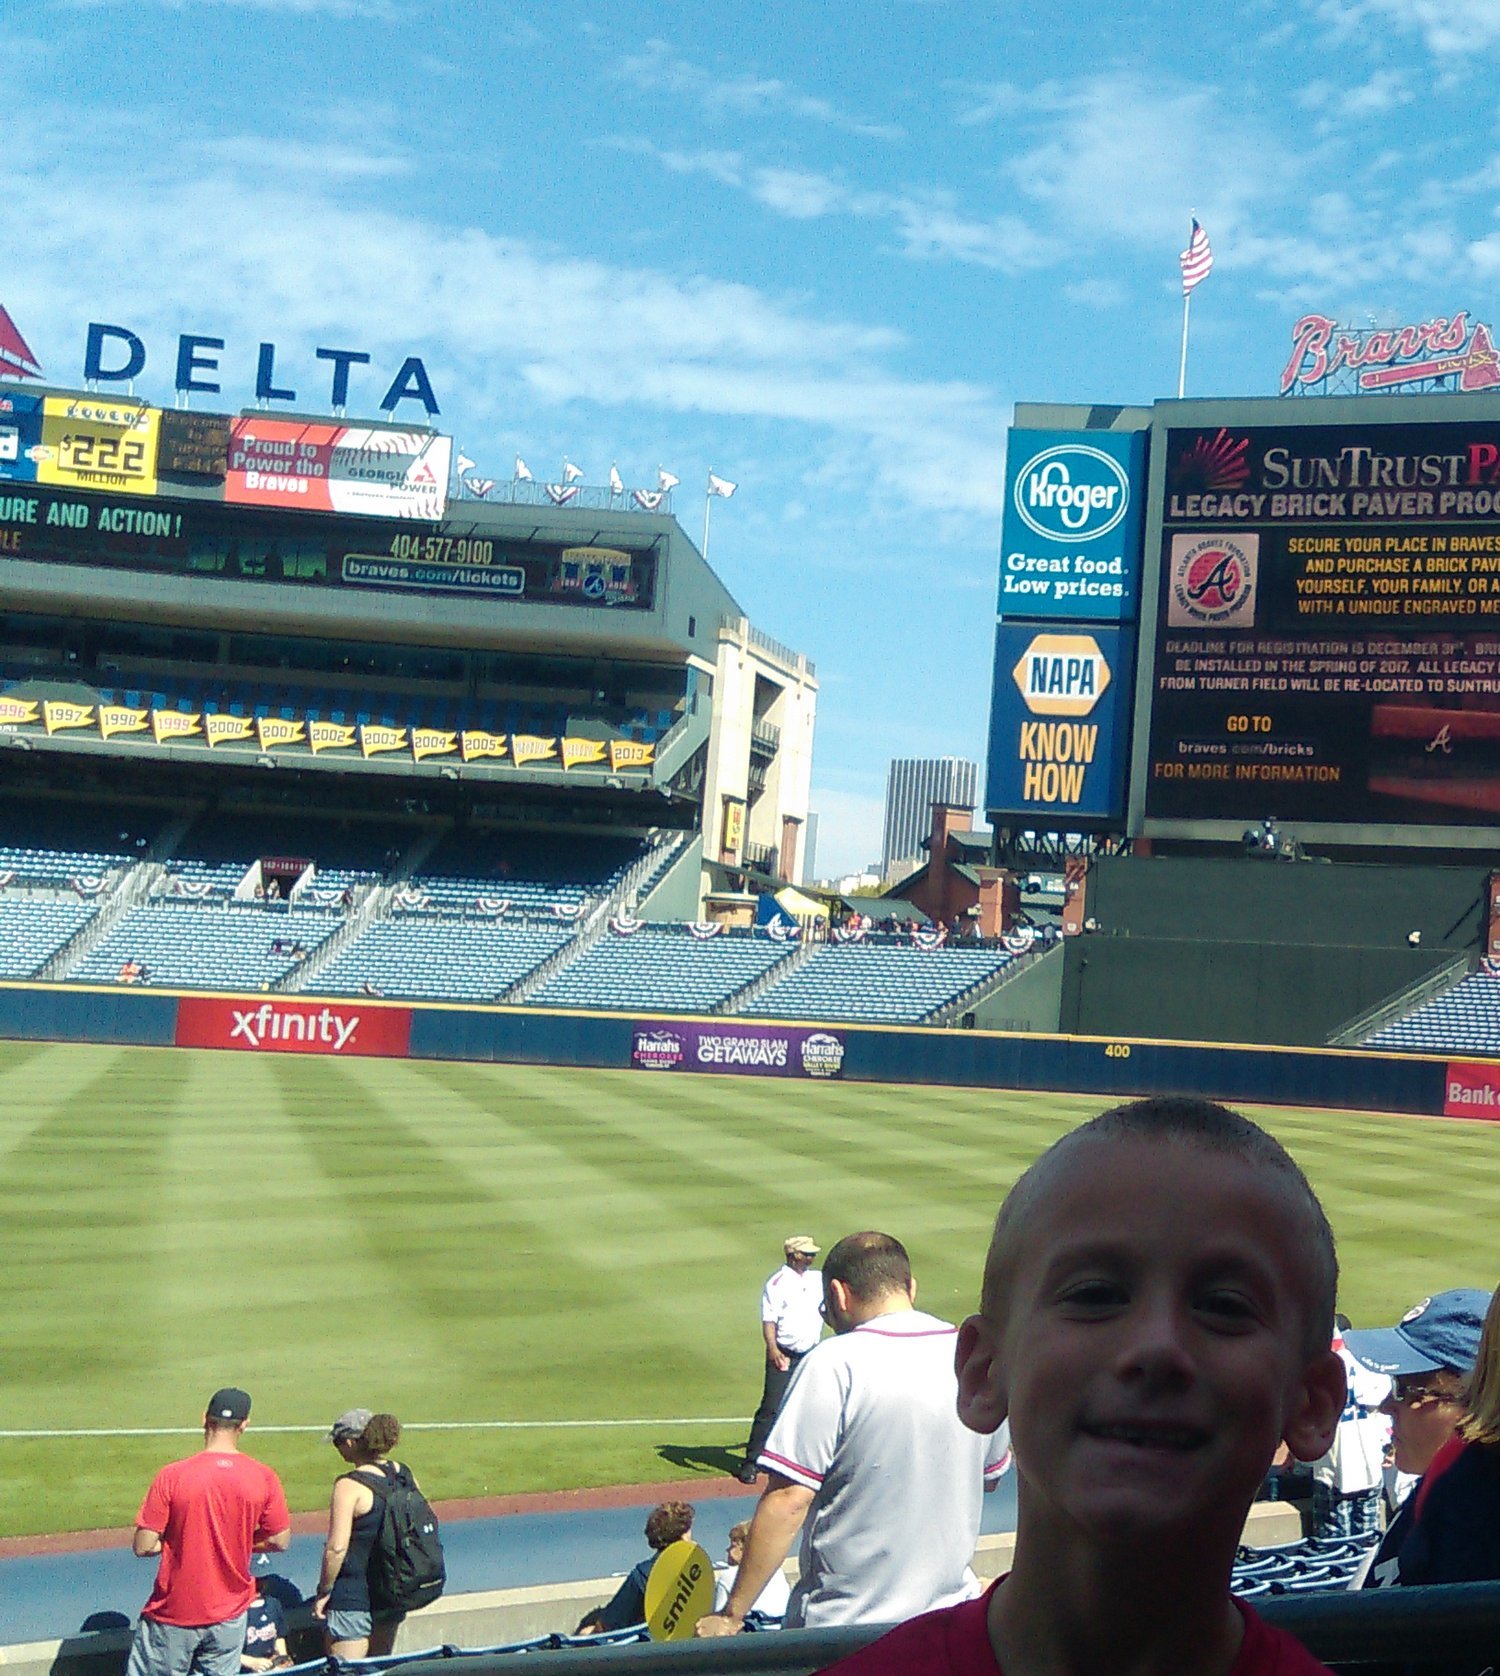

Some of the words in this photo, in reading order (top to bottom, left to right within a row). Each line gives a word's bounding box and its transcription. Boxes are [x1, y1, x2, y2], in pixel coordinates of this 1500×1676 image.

[1280, 310, 1471, 396] Braves
[85, 322, 440, 415] DELTA
[62, 434, 144, 471] $222
[244, 434, 297, 454] Proud
[300, 443, 317, 458] to
[233, 452, 295, 474] Power
[297, 461, 324, 476] the
[77, 470, 126, 486] MILLION
[245, 472, 308, 493] Braves
[349, 467, 409, 481] GEORGIA
[389, 482, 438, 495] POWER
[1030, 461, 1119, 528] Kroger
[1170, 493, 1267, 517] LEGACY
[1270, 492, 1347, 517] BRICK
[1352, 491, 1435, 516] PAVER
[46, 502, 89, 528] AND
[390, 534, 493, 565] 404-577-9100
[1288, 537, 1342, 554] SECURE
[1344, 536, 1382, 553] YOUR
[1385, 536, 1429, 552] PLACE
[1432, 536, 1447, 552] IN
[1007, 553, 1070, 573] Great
[1074, 556, 1129, 575] food.
[1305, 558, 1334, 573] AND
[1337, 558, 1410, 573] PURCHASE
[1413, 558, 1423, 573] A
[1426, 557, 1468, 572] BRICK
[350, 561, 518, 587] braves.com/tickets
[1004, 575, 1050, 595] Low
[1054, 577, 1129, 600] prices.
[1296, 579, 1369, 594] YOURSELF,
[1372, 578, 1409, 594] YOUR
[1468, 577, 1487, 593] OR
[1491, 578, 1500, 593] A
[1298, 599, 1333, 614] WITH
[1336, 600, 1345, 614] A
[1348, 599, 1400, 615] UNIQUE
[1404, 599, 1476, 615] ENGRAVED
[1166, 641, 1224, 654] DEADLINE
[1228, 641, 1254, 654] FOR
[1257, 641, 1348, 655] REGISTRATION
[1352, 642, 1364, 655] IS
[1367, 642, 1438, 655] DECEMBER
[1175, 659, 1191, 672] BE
[1194, 659, 1261, 673] INSTALLED
[1264, 660, 1278, 672] IN
[1281, 660, 1305, 673] THE
[1309, 660, 1357, 673] SPRING
[1360, 661, 1377, 673] OF
[1416, 661, 1441, 674] ALL
[1444, 661, 1495, 674] LEGACY
[1030, 656, 1094, 695] NAPA
[1160, 677, 1196, 690] FROM
[1199, 677, 1249, 690] TURNER
[1252, 678, 1287, 691] FIELD
[1290, 678, 1320, 691] WILL
[1324, 679, 1340, 691] BE
[1344, 679, 1423, 692] RE-LOCATED
[1427, 679, 1444, 692] TO
[50, 709, 82, 721] 1997
[104, 713, 137, 726] 1998
[1227, 715, 1249, 732] GO
[1252, 715, 1272, 732] TO
[158, 718, 190, 730] 1999
[210, 722, 243, 734] 2000
[263, 726, 294, 738] 2001
[312, 728, 345, 742] 2002
[364, 733, 397, 745] 2003
[415, 736, 446, 748] 2004
[1019, 721, 1098, 763] KNOW
[465, 739, 496, 751] 2005
[1178, 741, 1314, 756] bravescom/bricks
[615, 748, 644, 760] 2013
[1154, 763, 1184, 778] FOR
[1188, 763, 1230, 779] MORE
[1235, 765, 1340, 781] INFORMATION
[1023, 762, 1085, 803] HOW
[230, 1004, 360, 1050] xfinity
[699, 1036, 721, 1046] TWO
[723, 1037, 758, 1048] GRAND
[761, 1038, 788, 1050] SLAM
[1105, 1045, 1130, 1058] 400
[697, 1046, 787, 1066] GETAWAYS
[1449, 1082, 1495, 1105] Bank
[662, 1563, 703, 1635] smile
